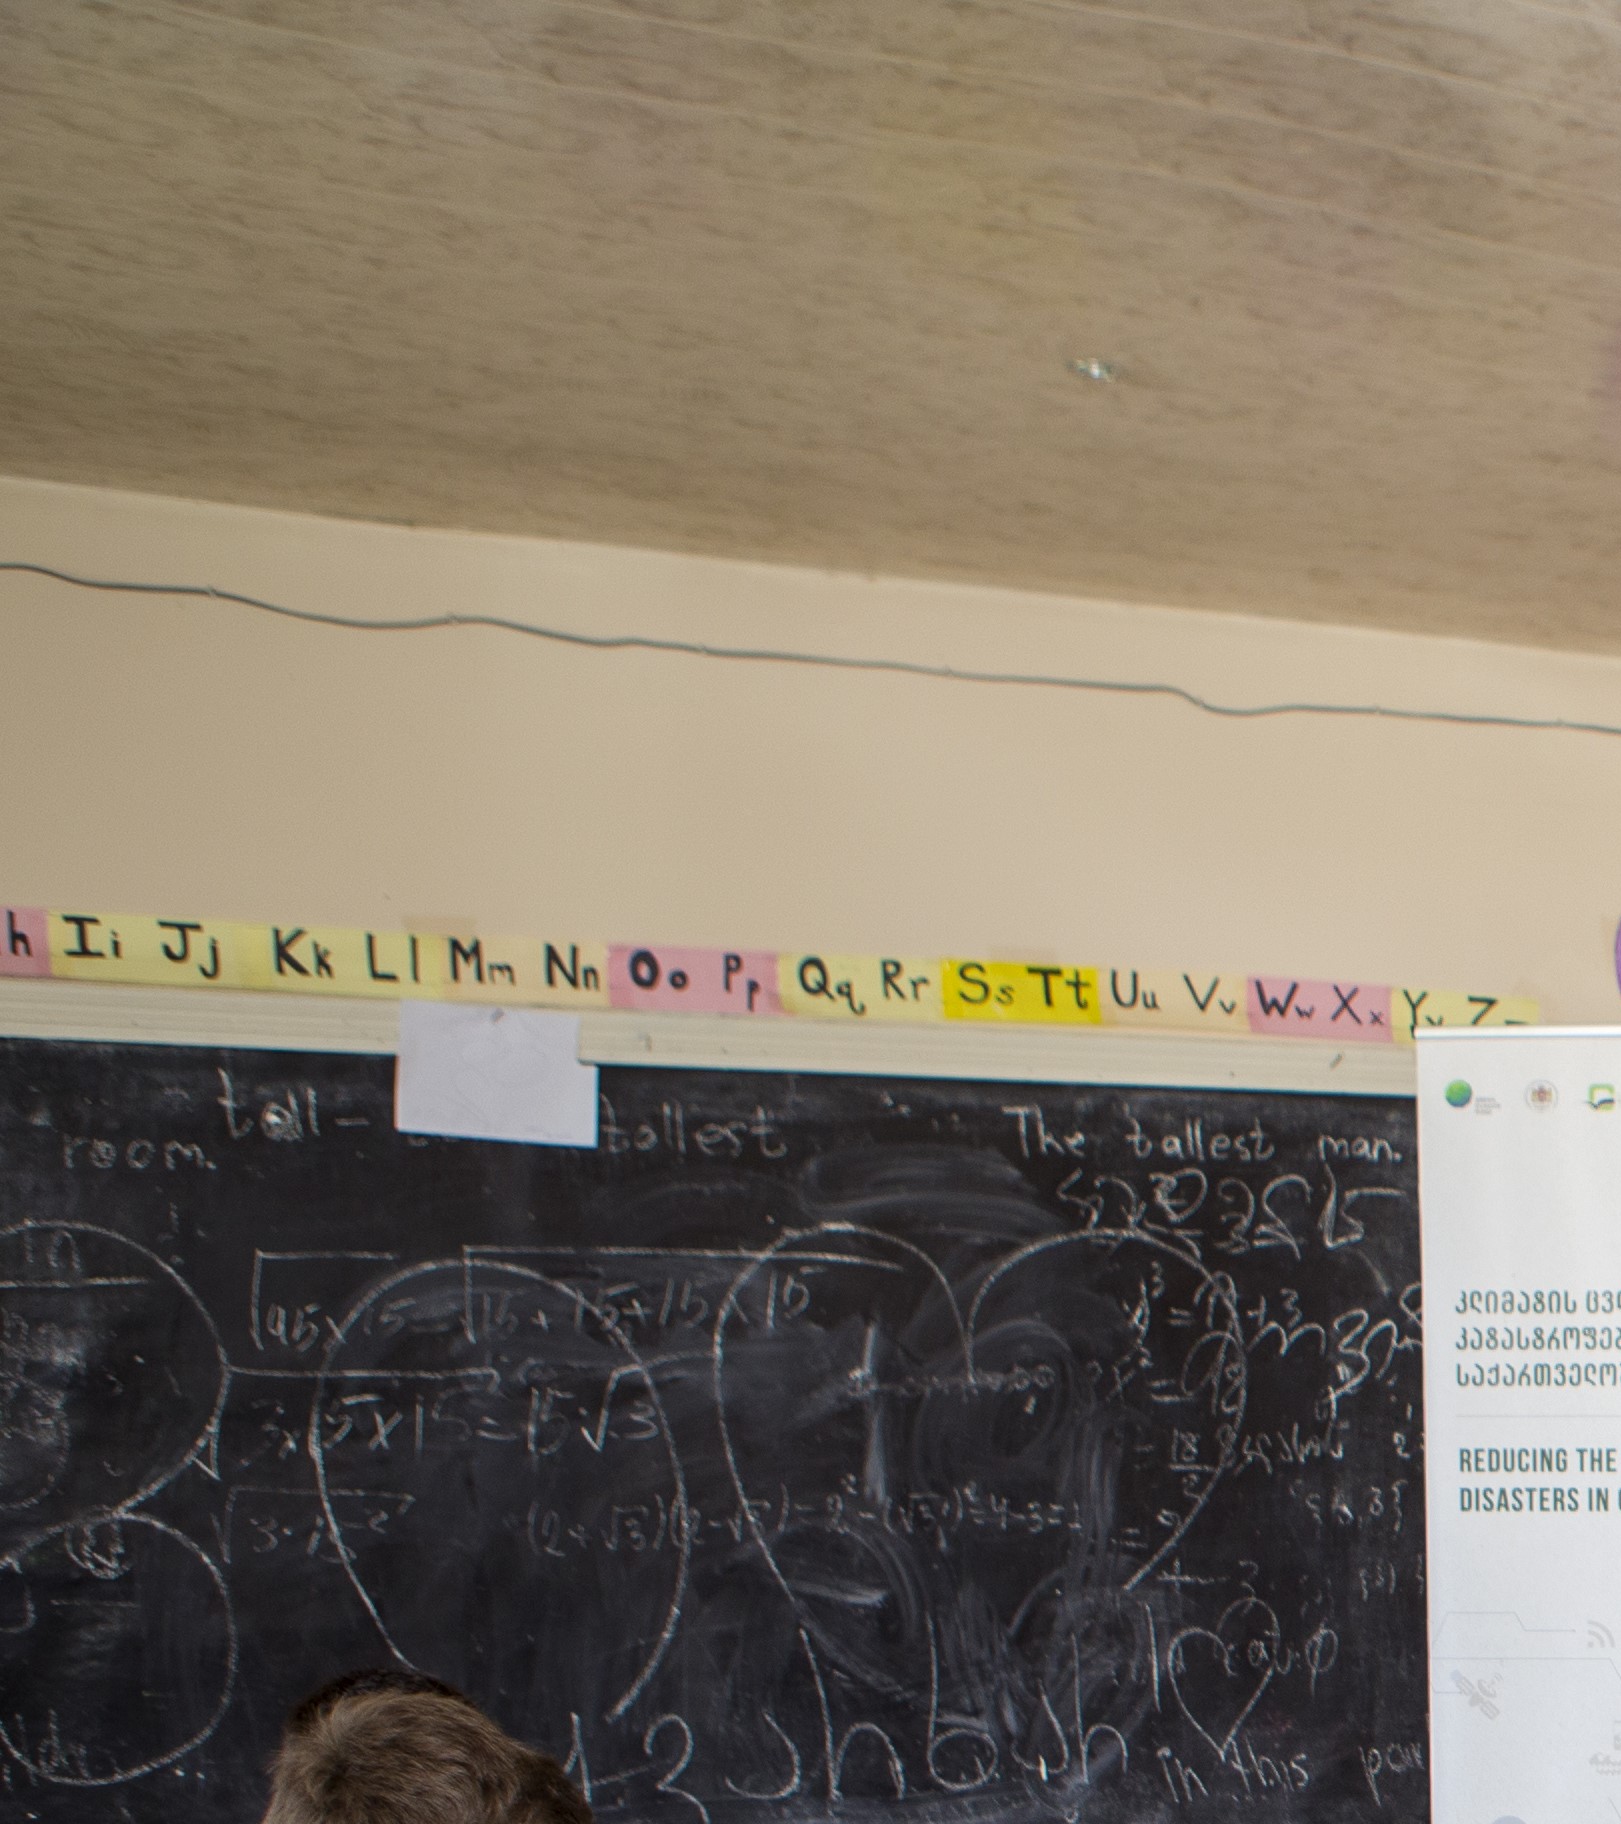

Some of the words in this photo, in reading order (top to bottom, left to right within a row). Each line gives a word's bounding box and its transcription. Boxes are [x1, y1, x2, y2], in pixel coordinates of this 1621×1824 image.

[156, 920, 221, 979] Jj
[271, 927, 333, 978] Kk
[449, 936, 517, 984] Mm
[544, 942, 601, 991] Nn
[722, 952, 762, 1012] Pp
[797, 956, 867, 1016] Qq
[880, 958, 930, 1001] Rr
[1026, 966, 1091, 1010] Tt
[1455, 1290, 1577, 1314] კლიმატის
[1459, 1448, 1568, 1473] REDUCING
[1576, 1448, 1617, 1473] THE
[1459, 1487, 1580, 1512] DISASTERS
[1588, 1487, 1609, 1512] IN
